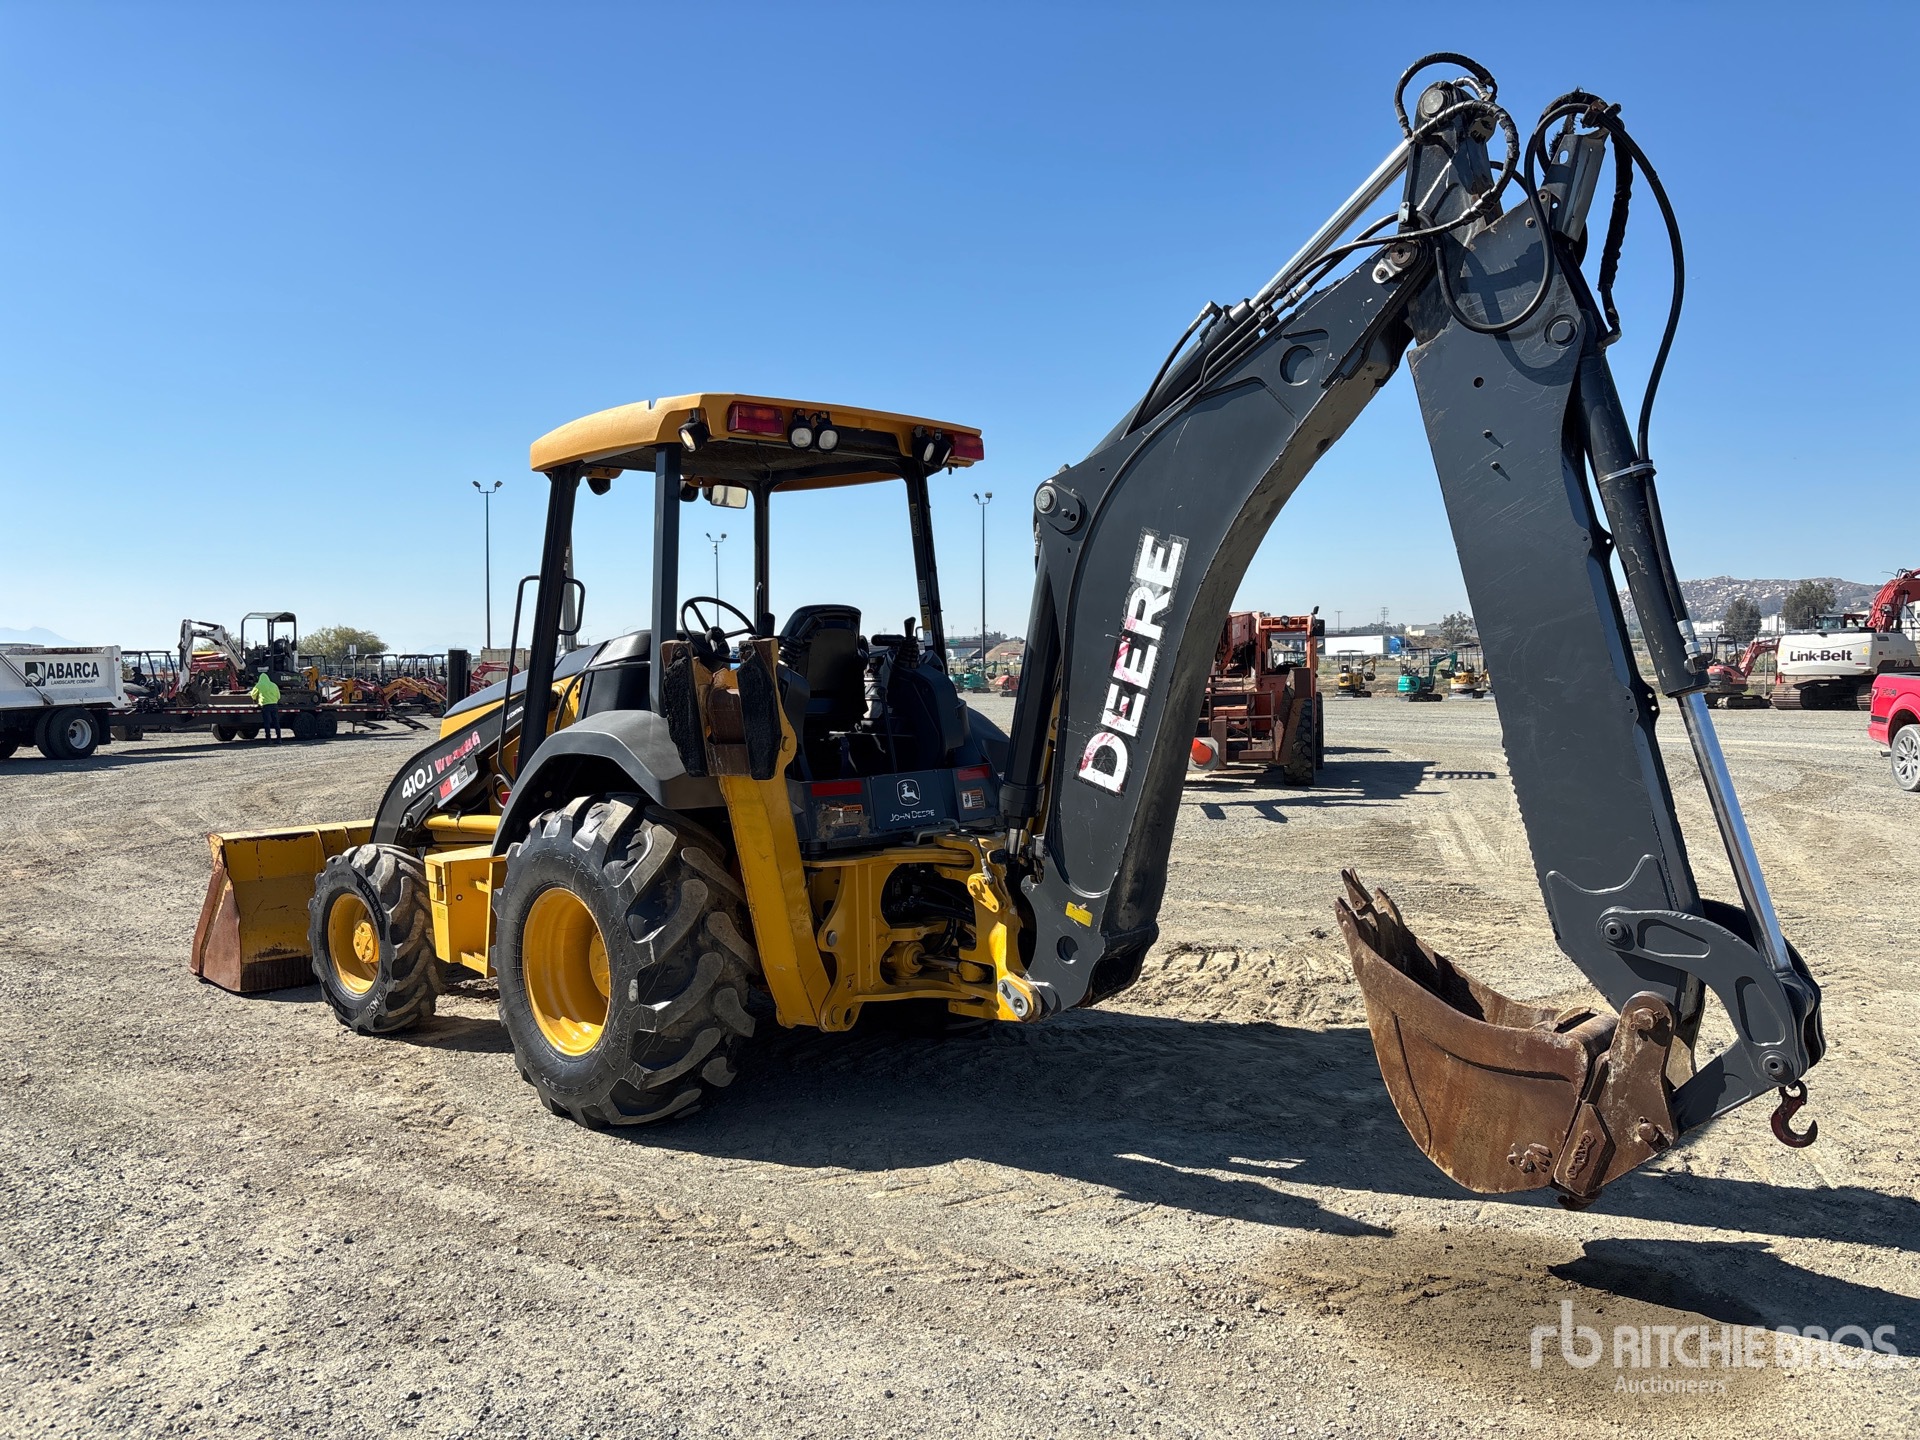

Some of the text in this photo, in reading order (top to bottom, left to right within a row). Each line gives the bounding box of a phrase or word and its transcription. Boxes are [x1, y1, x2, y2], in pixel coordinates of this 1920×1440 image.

[1078, 534, 1183, 794] DEERE
[1789, 649, 1853, 662] Link-Belt
[46, 661, 100, 680] ABARCA
[401, 764, 434, 799] 410J
[889, 812, 911, 822] JOHN
